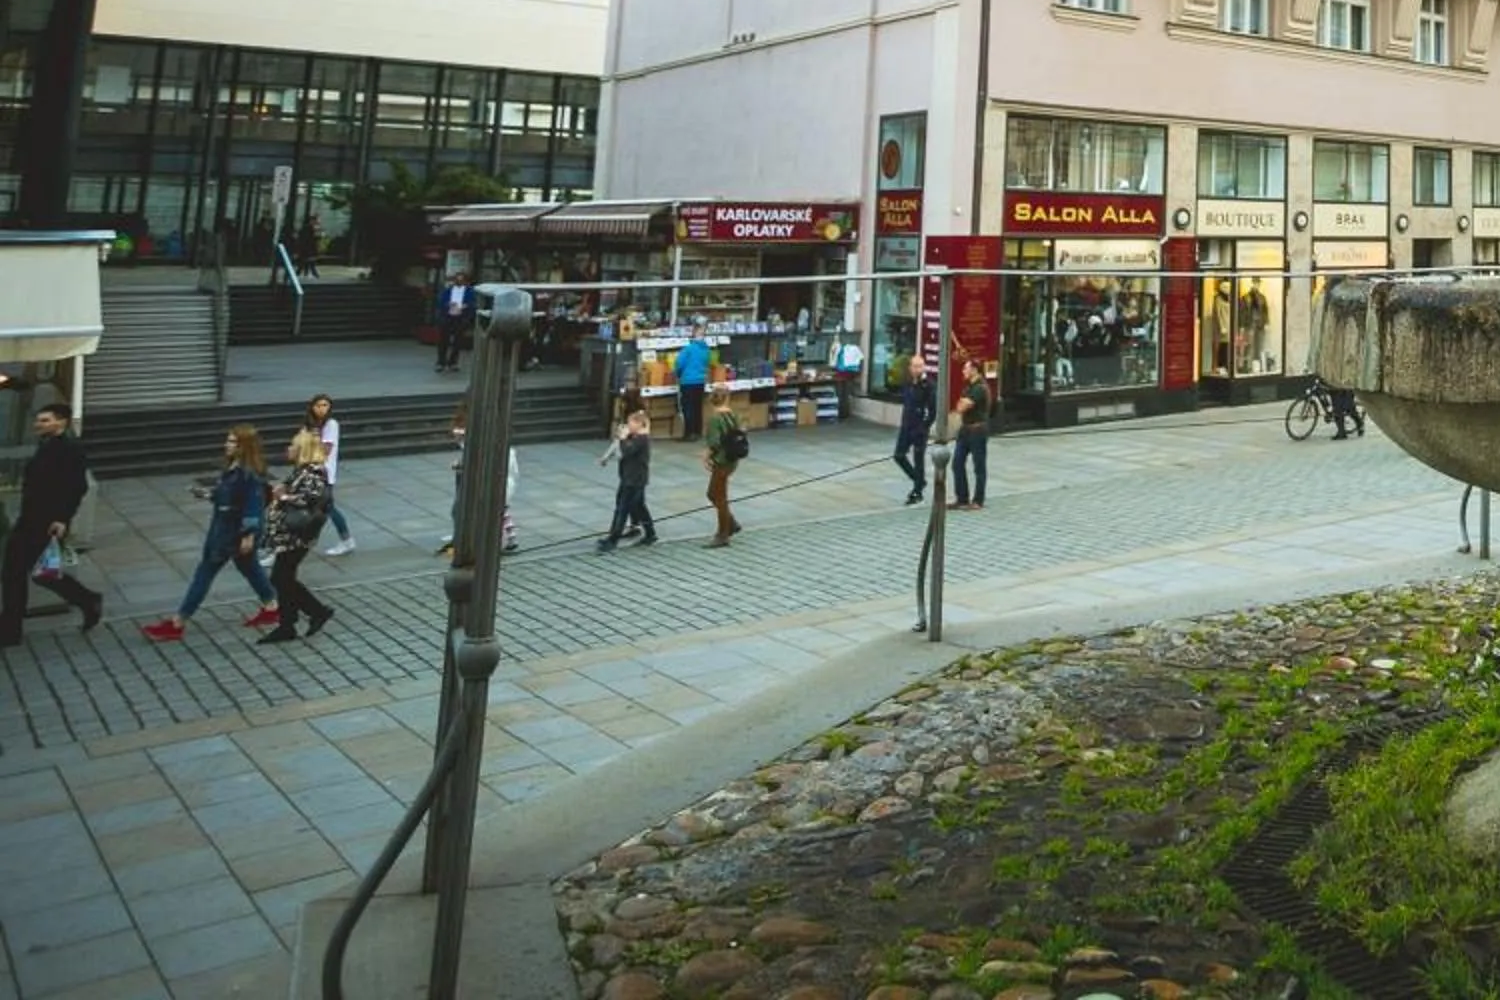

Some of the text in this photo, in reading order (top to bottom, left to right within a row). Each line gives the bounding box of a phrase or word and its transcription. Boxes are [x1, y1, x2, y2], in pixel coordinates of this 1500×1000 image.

[715, 206, 813, 222] KARLOVARSKÉ
[1013, 202, 1156, 224] SALON ALLA
[1205, 211, 1275, 229] BOUTIQUE
[732, 223, 795, 238] OPLATKY
